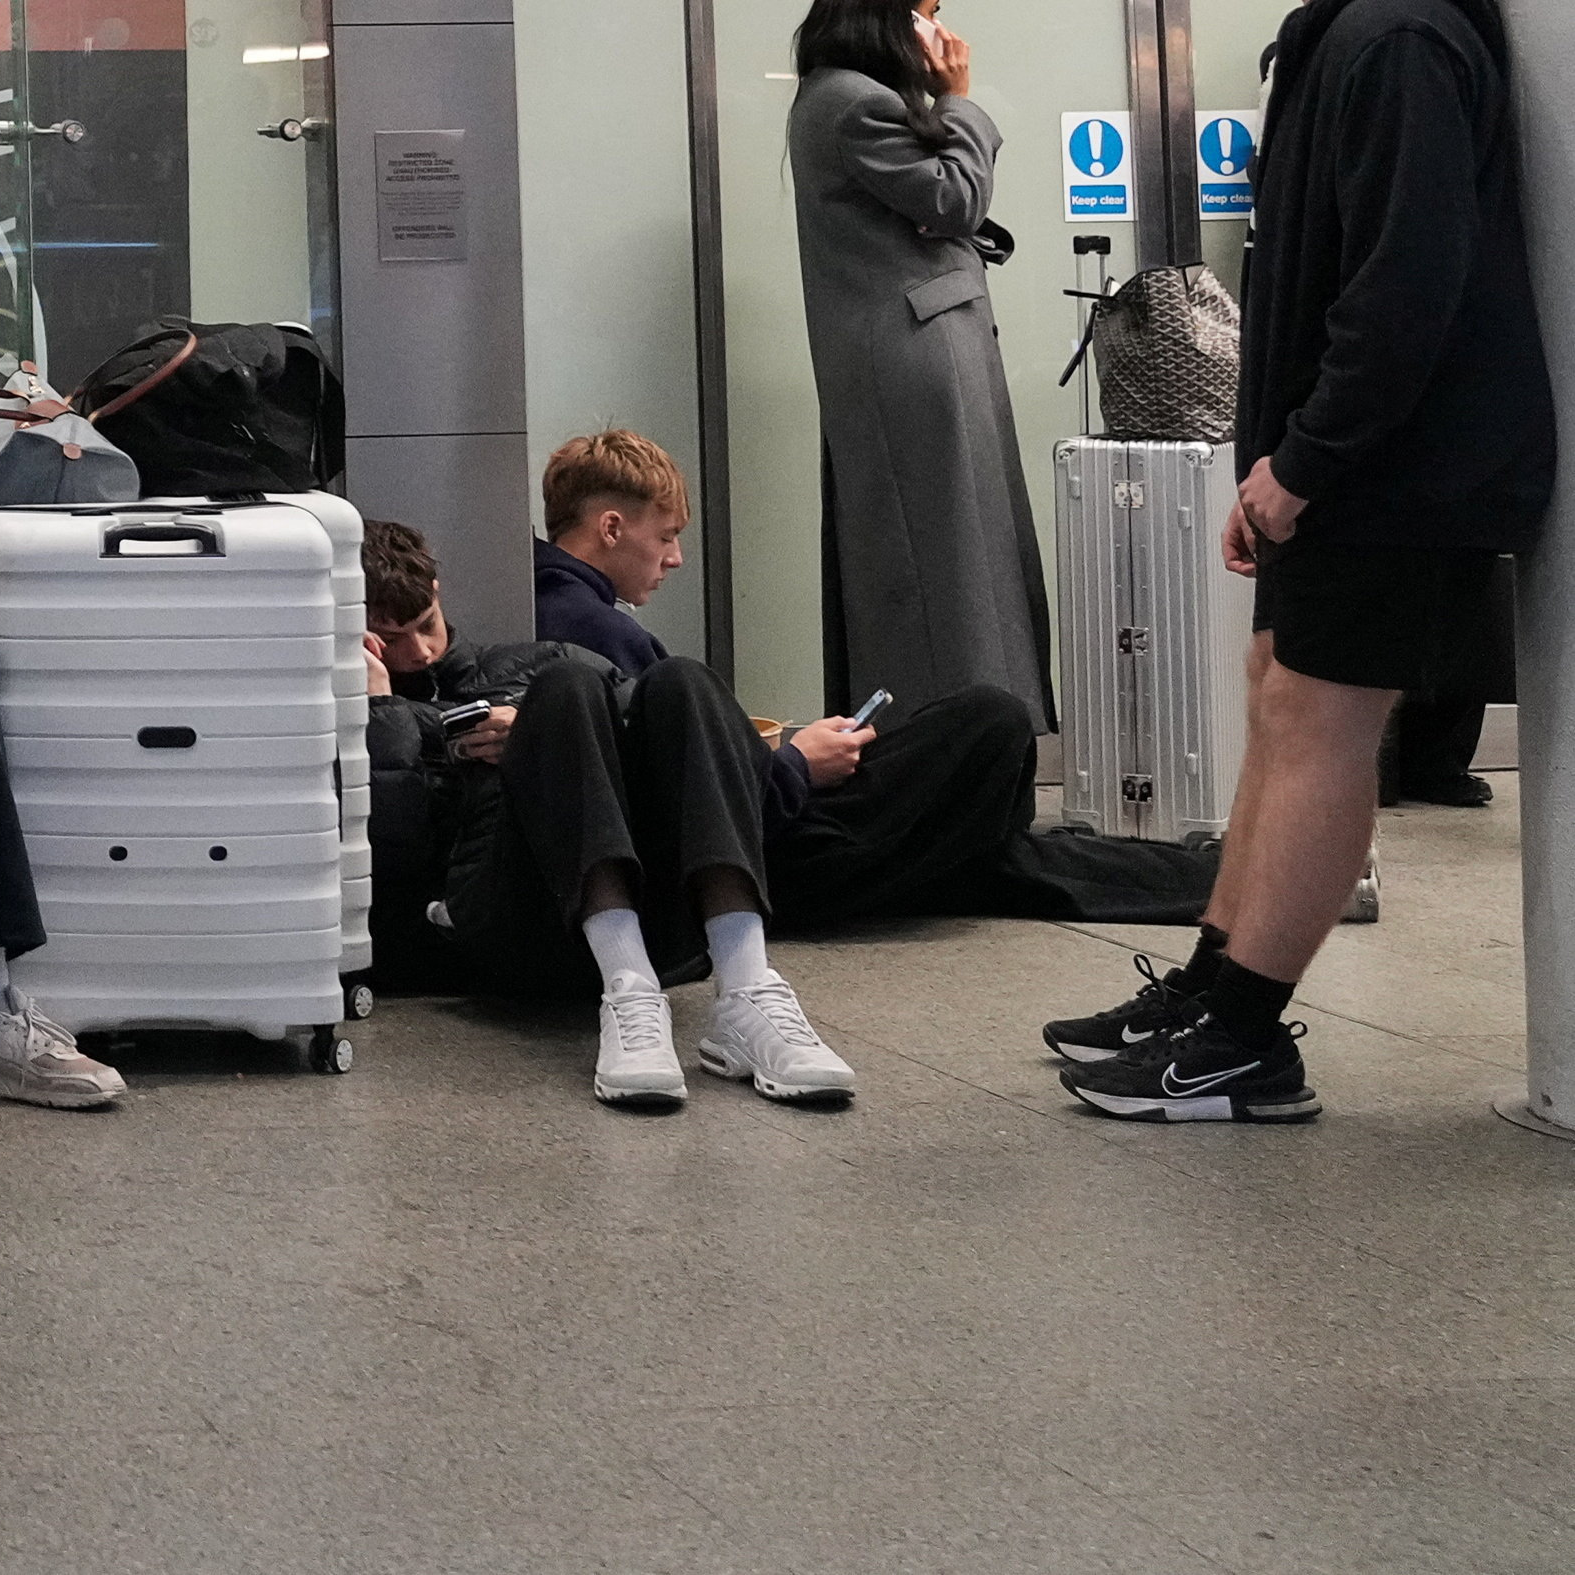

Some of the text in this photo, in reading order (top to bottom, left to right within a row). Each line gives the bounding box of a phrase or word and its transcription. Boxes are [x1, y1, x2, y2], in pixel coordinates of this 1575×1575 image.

[1071, 195, 1125, 206] Keep clear
[1202, 194, 1254, 205] Keep clea
